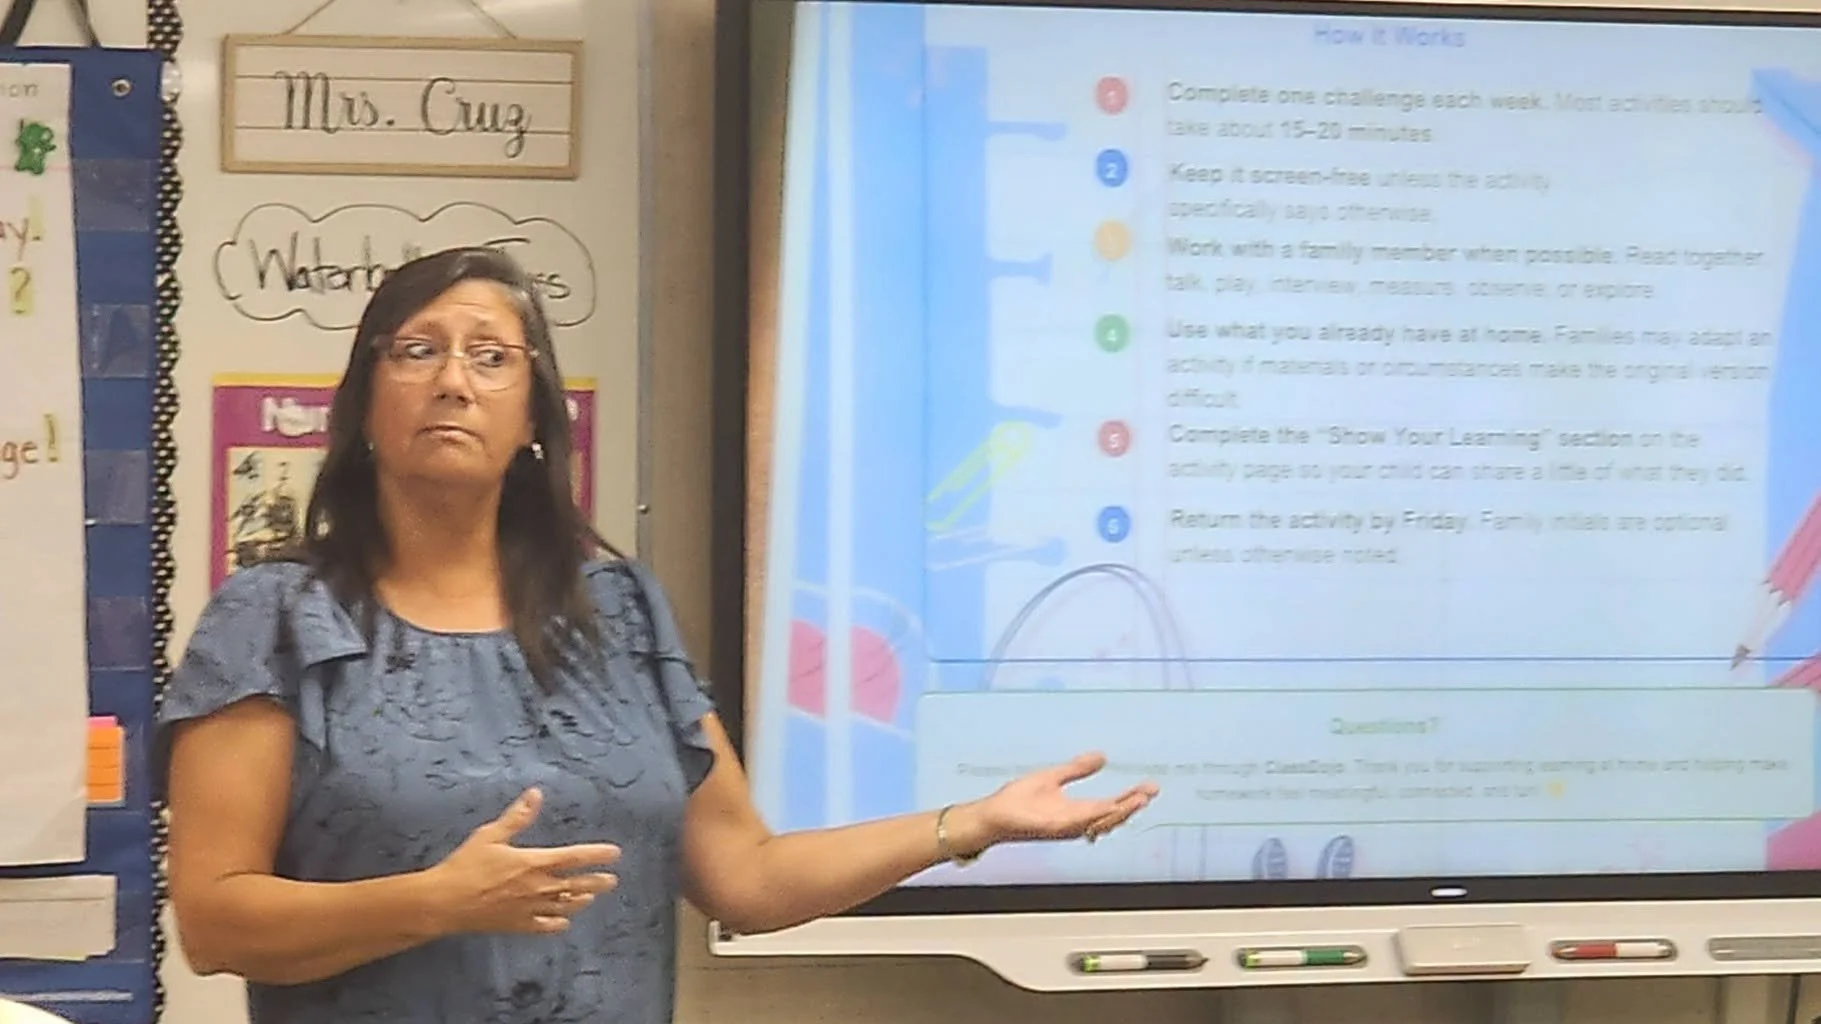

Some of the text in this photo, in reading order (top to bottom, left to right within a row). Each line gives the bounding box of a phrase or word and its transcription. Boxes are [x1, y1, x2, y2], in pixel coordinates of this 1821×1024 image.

[274, 71, 532, 158] Mrs. Cruz
[1167, 81, 1270, 108] Complete
[1277, 87, 1316, 104] one
